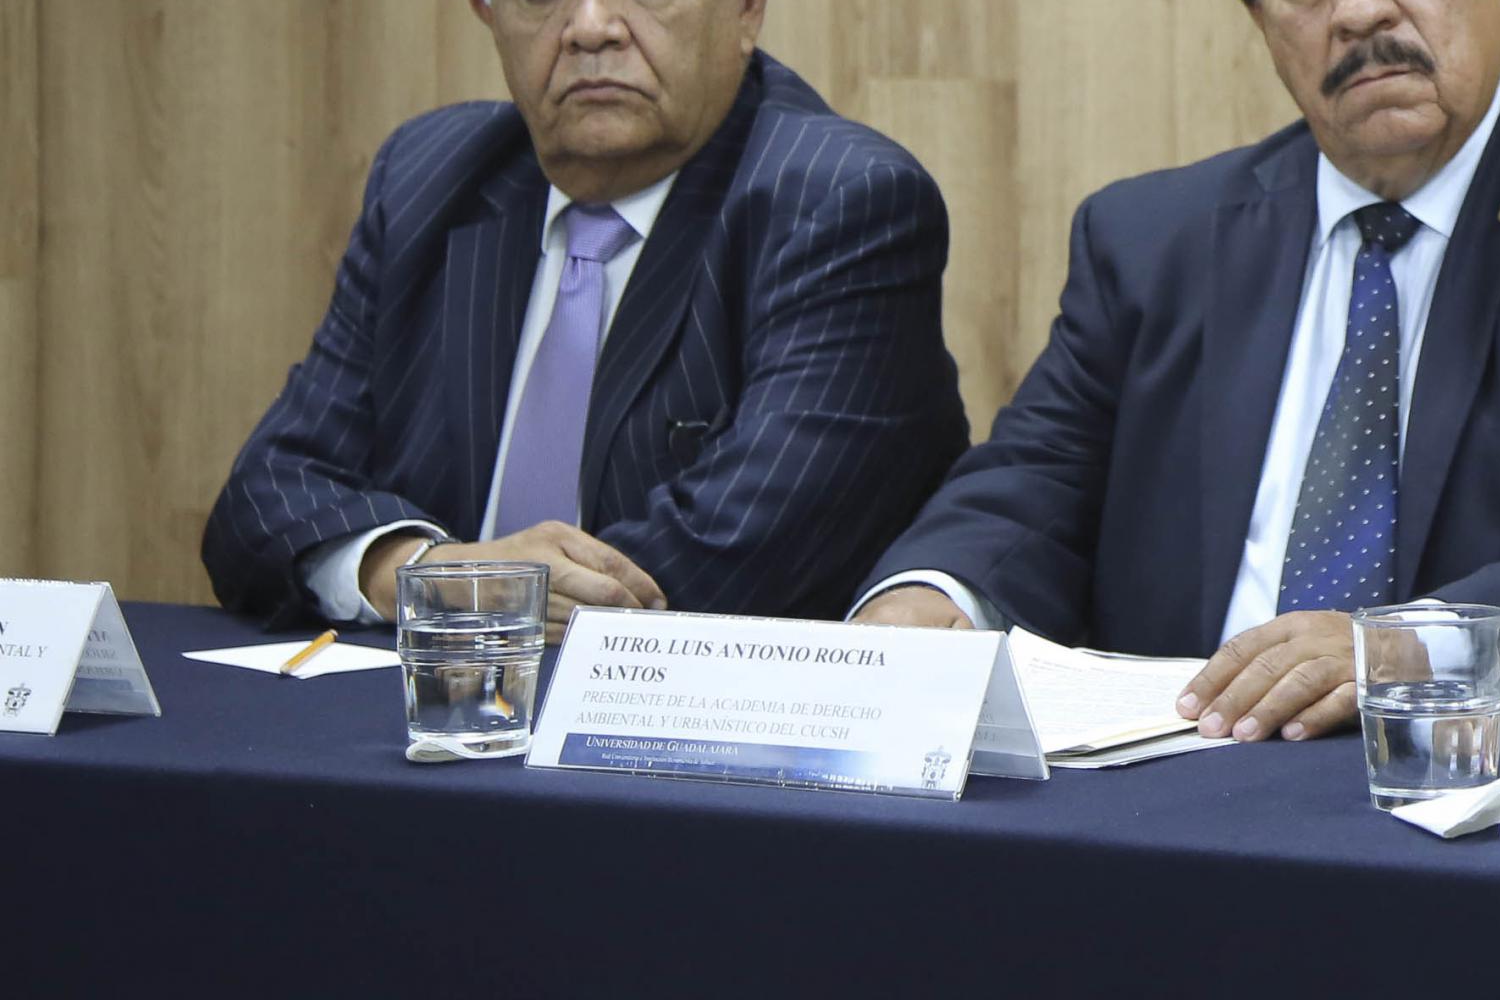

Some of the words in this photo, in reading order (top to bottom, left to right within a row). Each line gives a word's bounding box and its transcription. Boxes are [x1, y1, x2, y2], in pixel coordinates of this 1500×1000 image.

[600, 635, 662, 654] MTRO.
[668, 639, 714, 657] LUIS
[716, 642, 810, 663] ANTONIO
[814, 647, 886, 667] ROCHA
[589, 663, 667, 683] SANTOS
[582, 690, 666, 708] PRESIDENTE
[667, 694, 688, 708] DE
[688, 696, 707, 709] LA
[710, 697, 786, 715] ACADEMIA
[790, 702, 810, 716] DE
[811, 703, 882, 721] DERECHO
[575, 711, 655, 728] AMBIENTAL
[660, 714, 670, 728] Y
[672, 715, 767, 735] URBANÍSTICO
[769, 721, 797, 737] DEL
[800, 723, 850, 740] CUCSH
